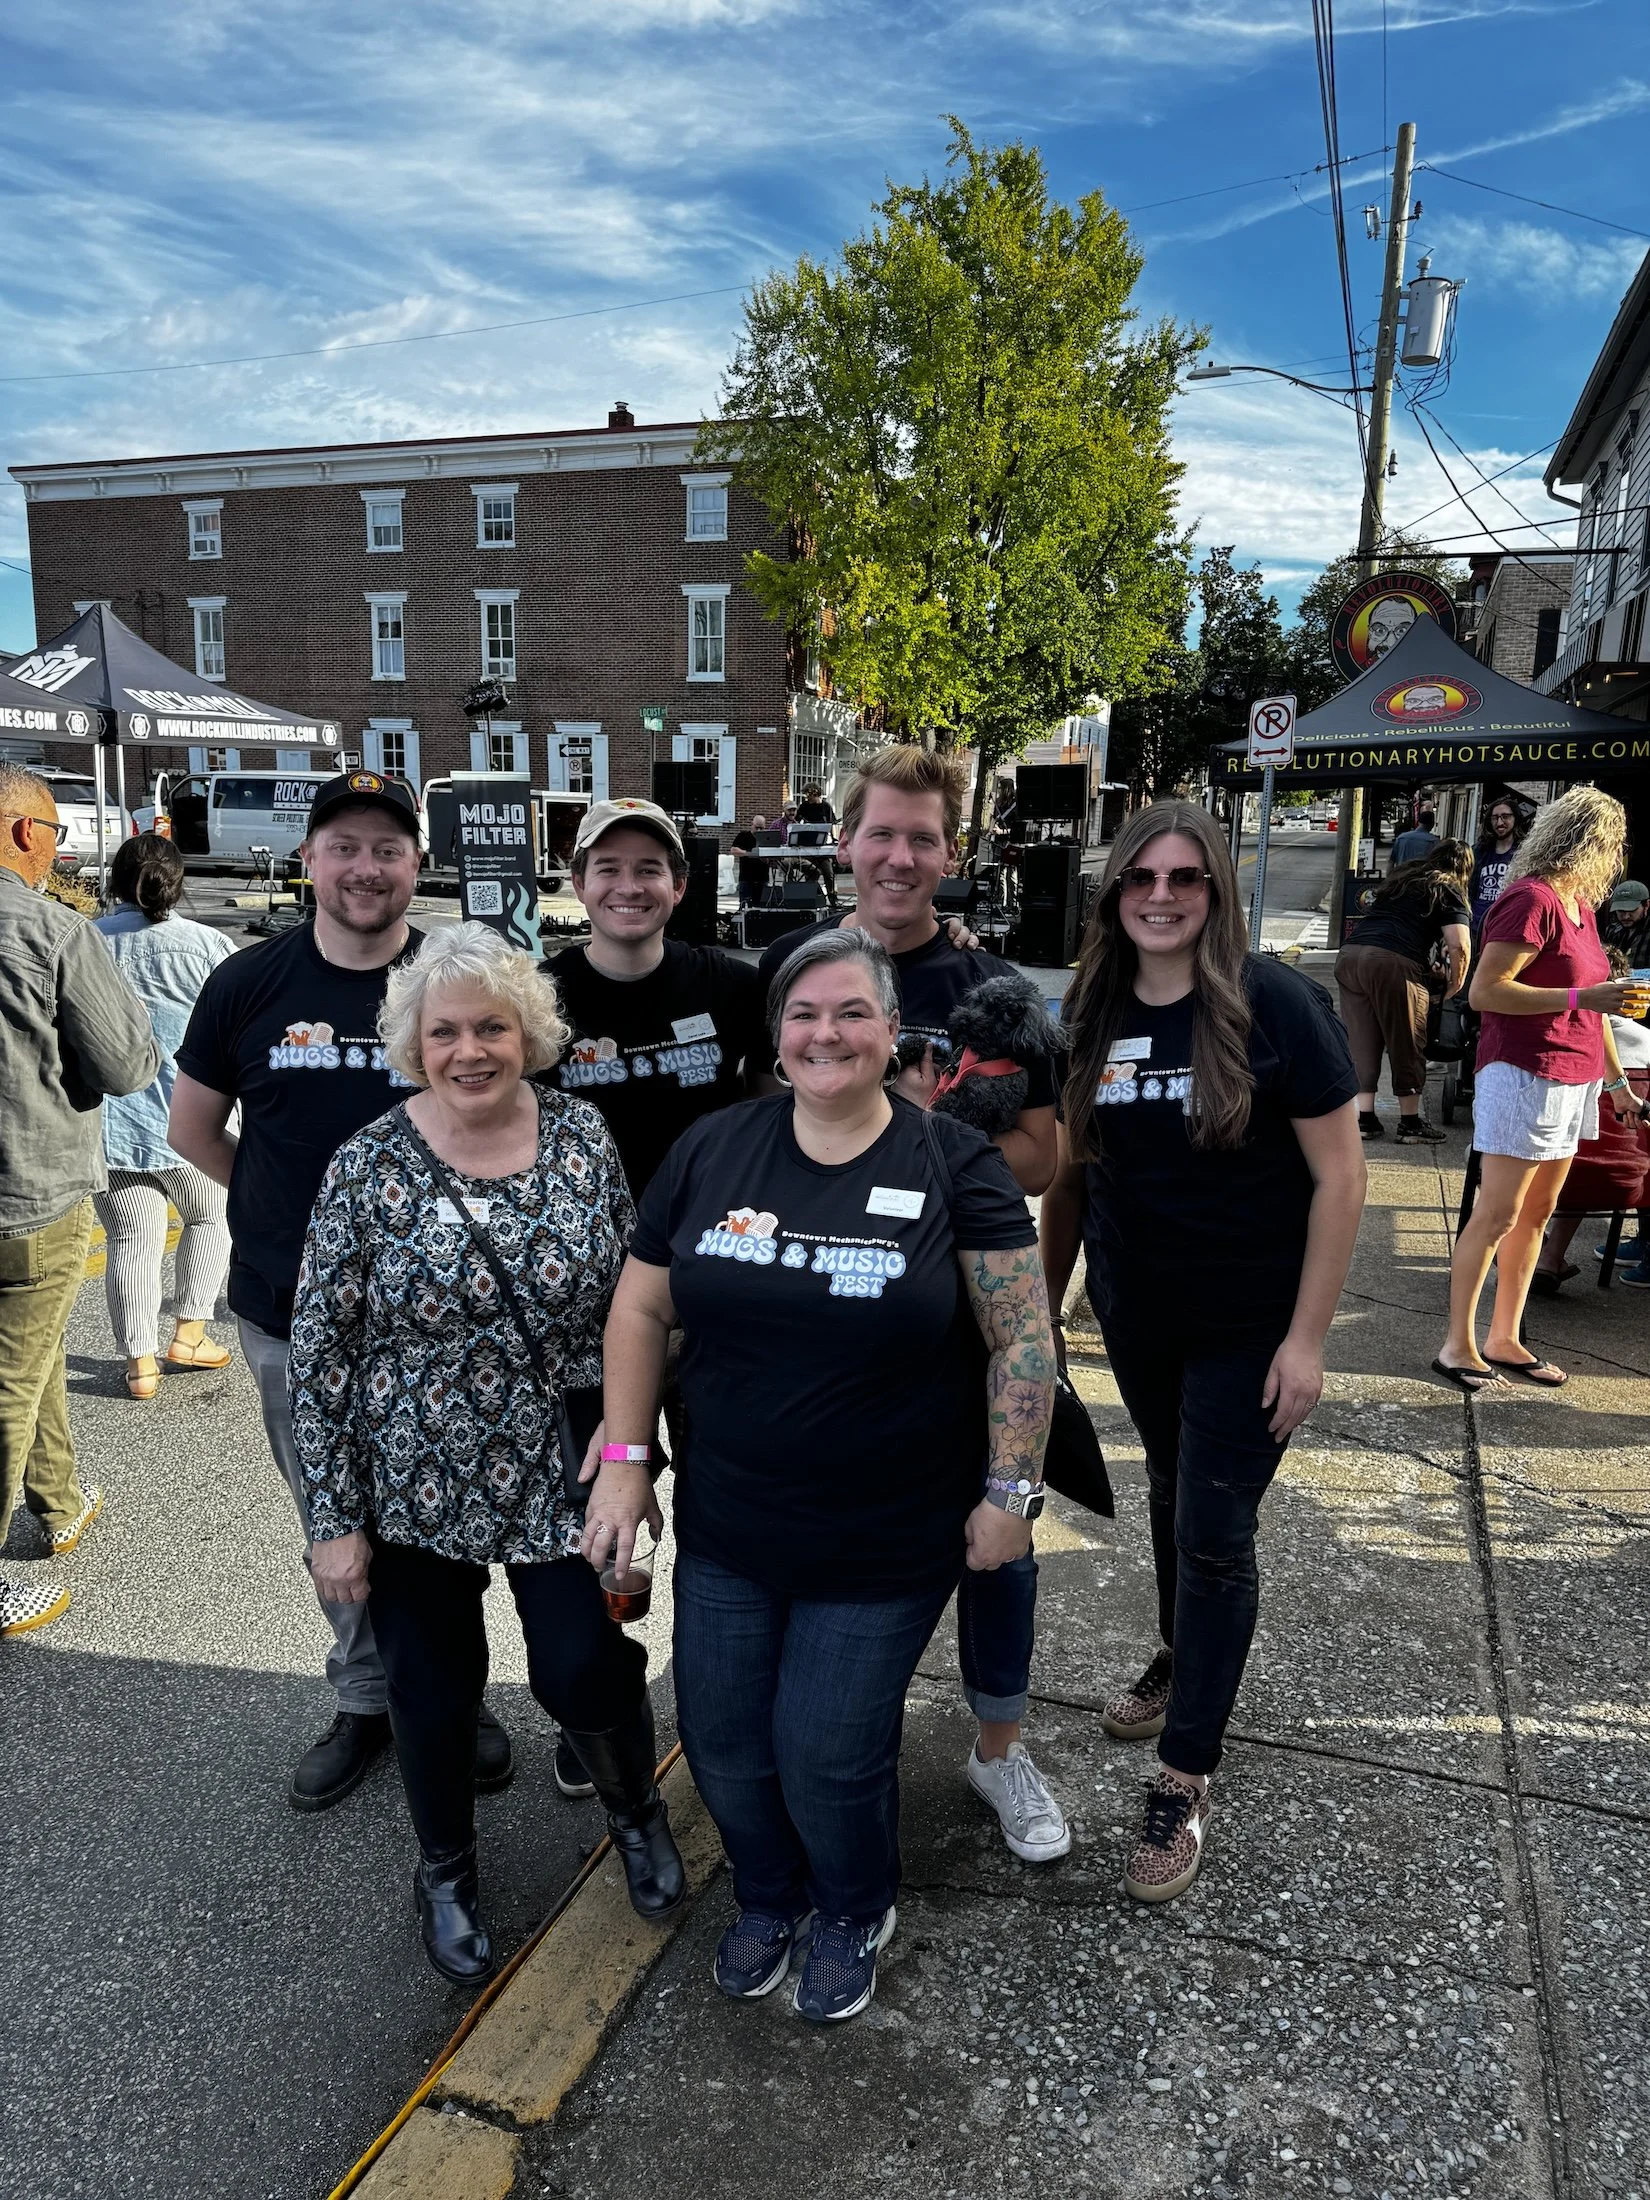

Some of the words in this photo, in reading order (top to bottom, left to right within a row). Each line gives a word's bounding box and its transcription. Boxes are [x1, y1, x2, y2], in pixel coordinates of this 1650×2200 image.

[1343, 575, 1451, 616] REVOLUTIONARY
[122, 687, 192, 711] ROCK
[640, 707, 660, 717] LOCUST
[156, 718, 318, 743] WWW.ROCKMILLINDUSTRIES.COM
[1293, 731, 1369, 743] Delicious
[1384, 724, 1475, 736] Rebellious
[1490, 721, 1571, 731] Beautiful
[274, 781, 308, 802] ROCK
[461, 826, 527, 846] FILTER
[270, 1046, 340, 1069] MUGS
[346, 1047, 366, 1068] &
[623, 1043, 660, 1054] Downtown
[560, 1059, 627, 1087] MUGS
[634, 1056, 652, 1076] &
[657, 1043, 721, 1073] MUSIC
[679, 1066, 716, 1087] FEST
[1096, 1081, 1137, 1104] UGS
[1143, 1079, 1161, 1099] &
[782, 1231, 827, 1242] Downtown
[697, 1230, 776, 1264] MUGS
[782, 1243, 807, 1267] &
[813, 1247, 904, 1277] MUSIC
[831, 1272, 885, 1297] FEST
